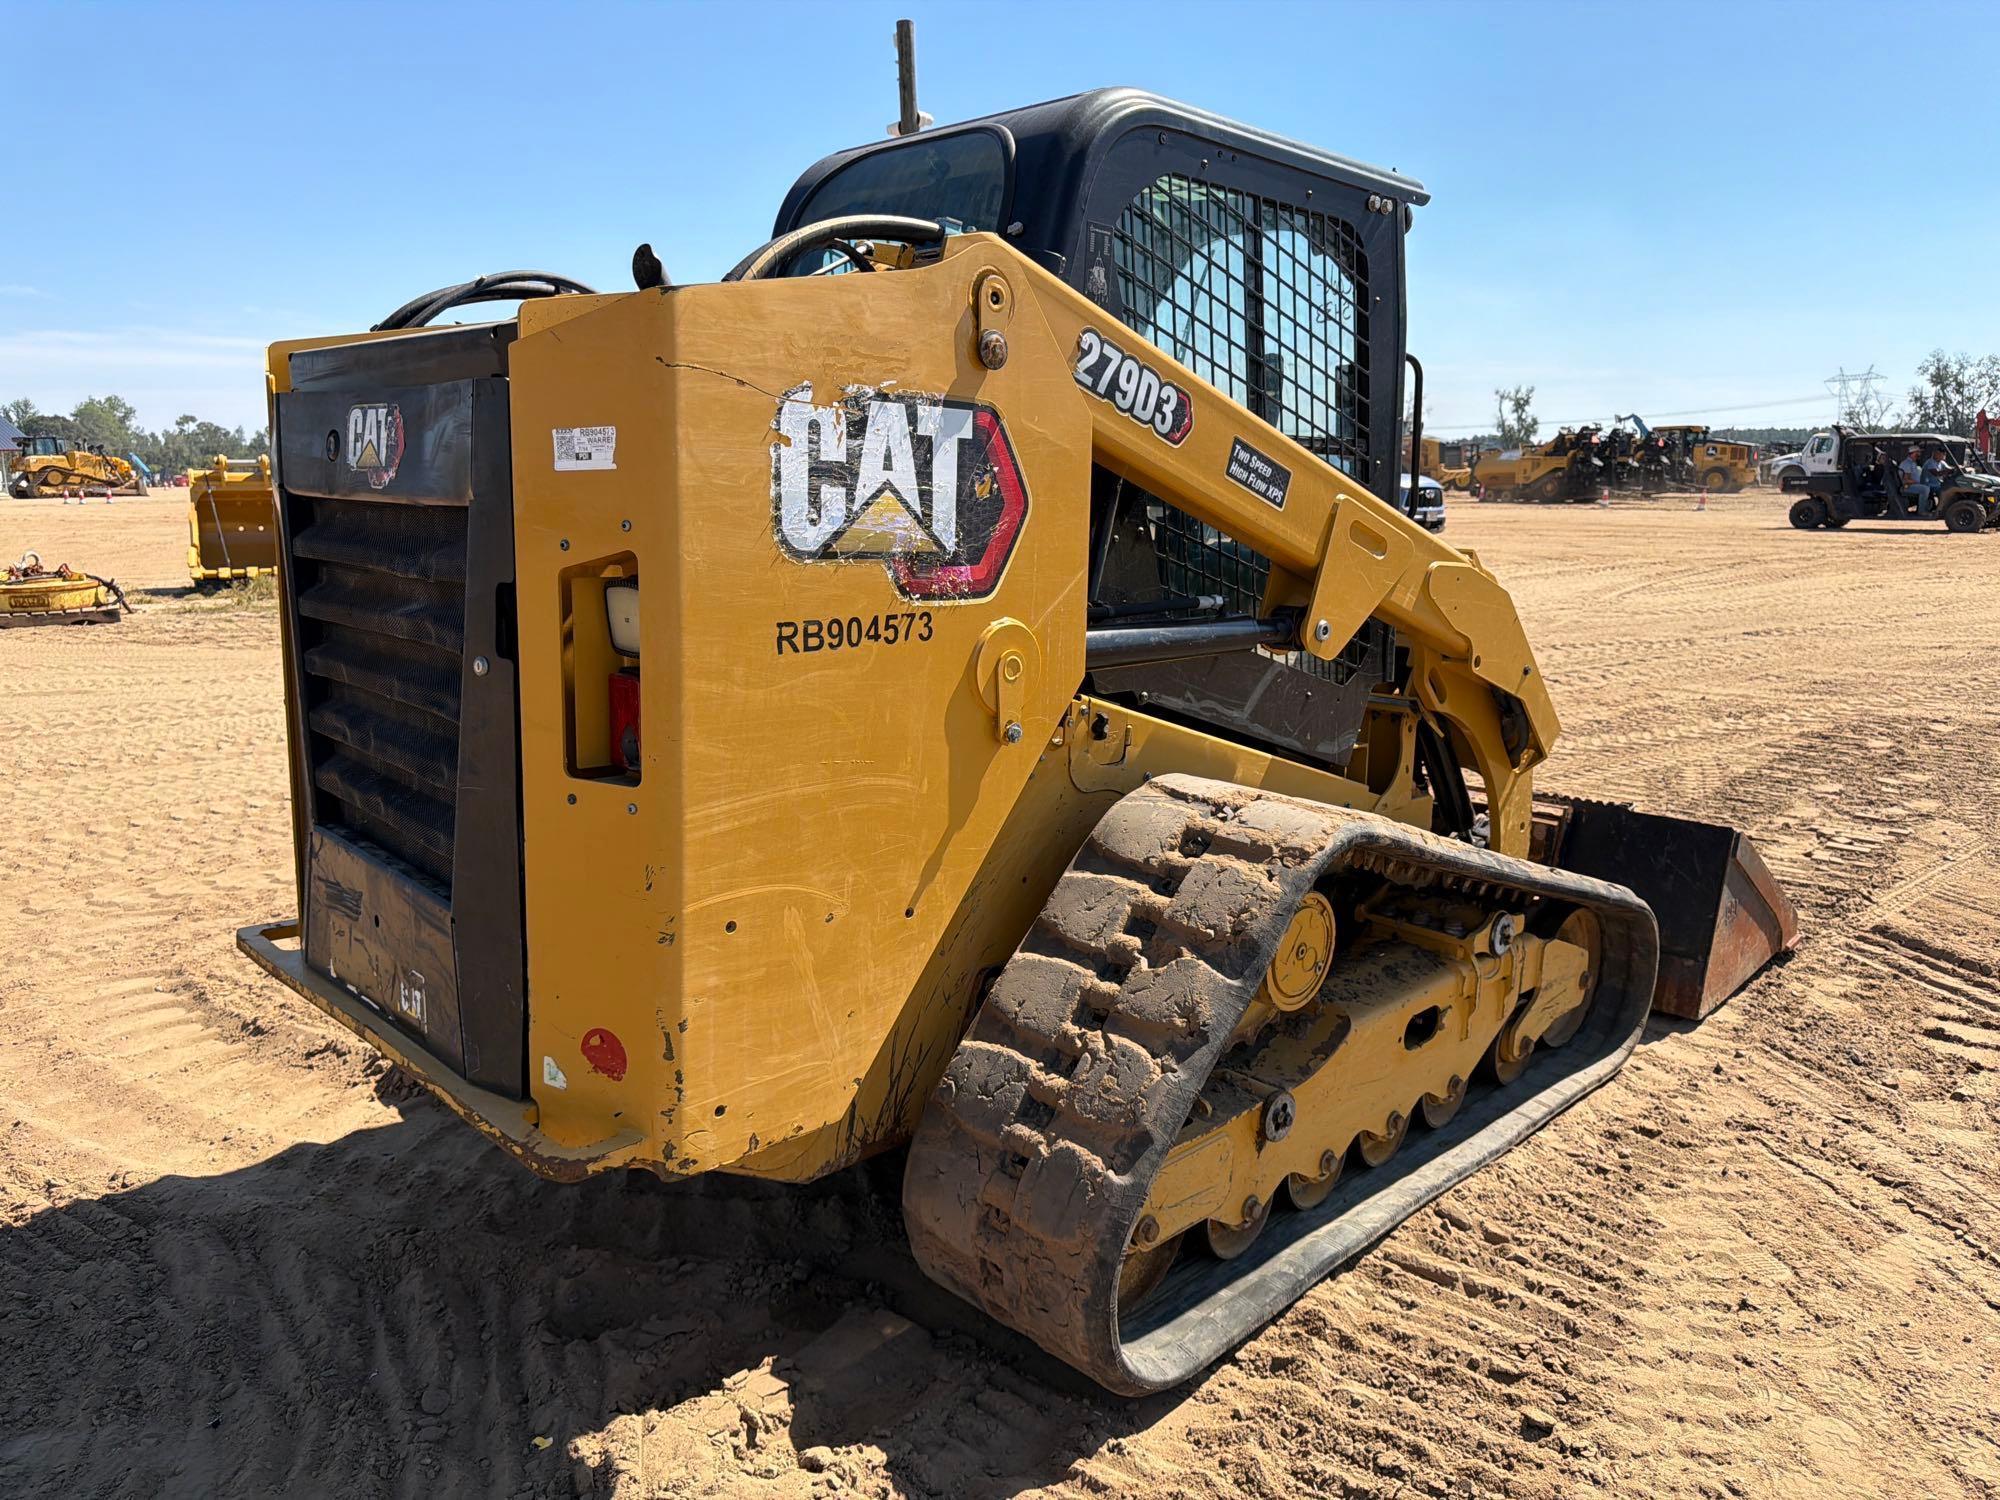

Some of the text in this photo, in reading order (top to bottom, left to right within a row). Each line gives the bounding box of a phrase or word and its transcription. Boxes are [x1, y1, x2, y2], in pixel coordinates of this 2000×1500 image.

[1073, 331, 1178, 434] 279D3
[348, 408, 388, 469] CAT
[580, 428, 615, 437] RB904573
[780, 398, 973, 552] CAT
[1266, 484, 1284, 503] XPS
[776, 611, 934, 655] RB904573
